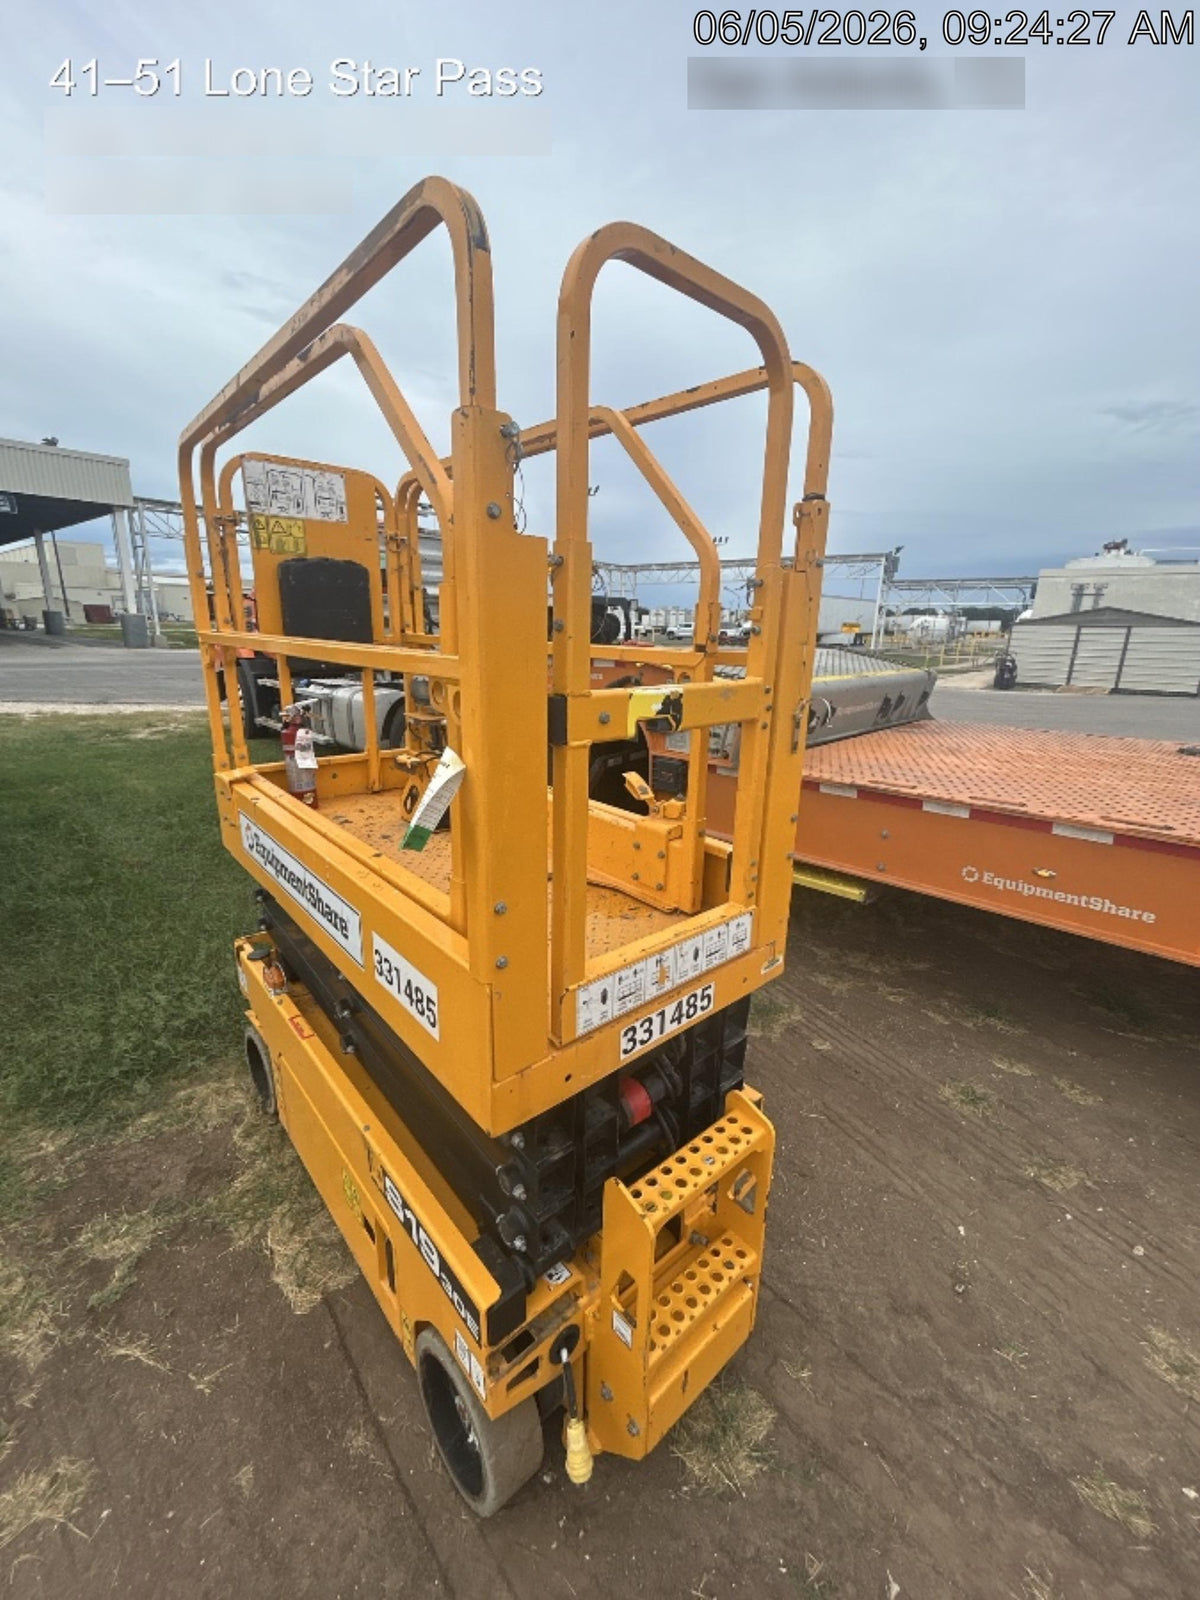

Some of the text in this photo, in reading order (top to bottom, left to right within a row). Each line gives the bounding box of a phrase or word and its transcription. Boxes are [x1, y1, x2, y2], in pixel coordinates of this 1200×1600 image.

[253, 831, 350, 940] EquipmentShare
[982, 871, 1156, 923] EquipmentShare
[375, 949, 437, 1029] 331485
[622, 984, 713, 1055] 331485
